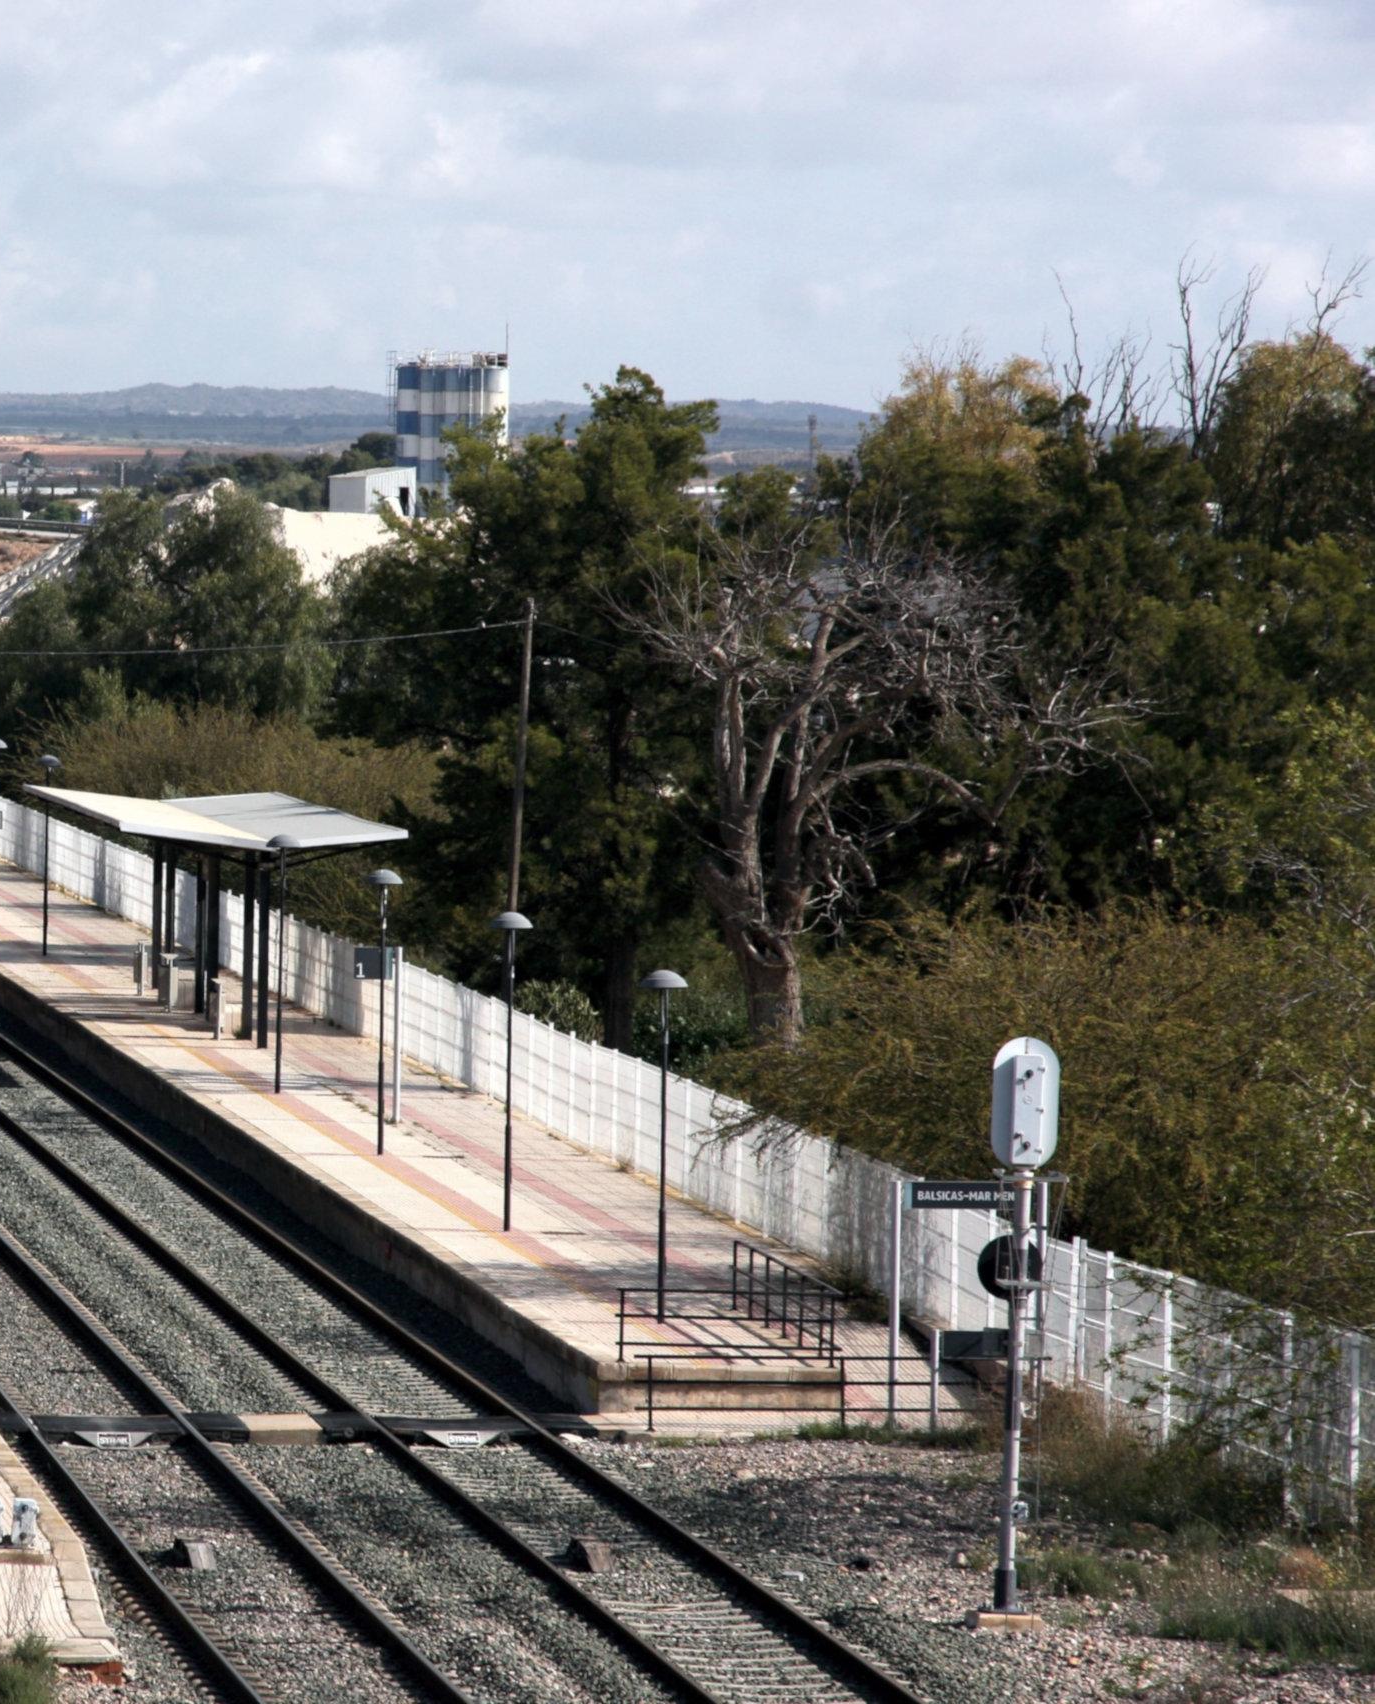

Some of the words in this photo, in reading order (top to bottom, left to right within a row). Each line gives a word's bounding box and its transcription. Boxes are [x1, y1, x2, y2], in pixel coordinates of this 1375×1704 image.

[355, 962, 365, 978] 1
[917, 1190, 992, 1201] BALSICAS-MAR
[993, 1190, 1015, 1201] MEN
